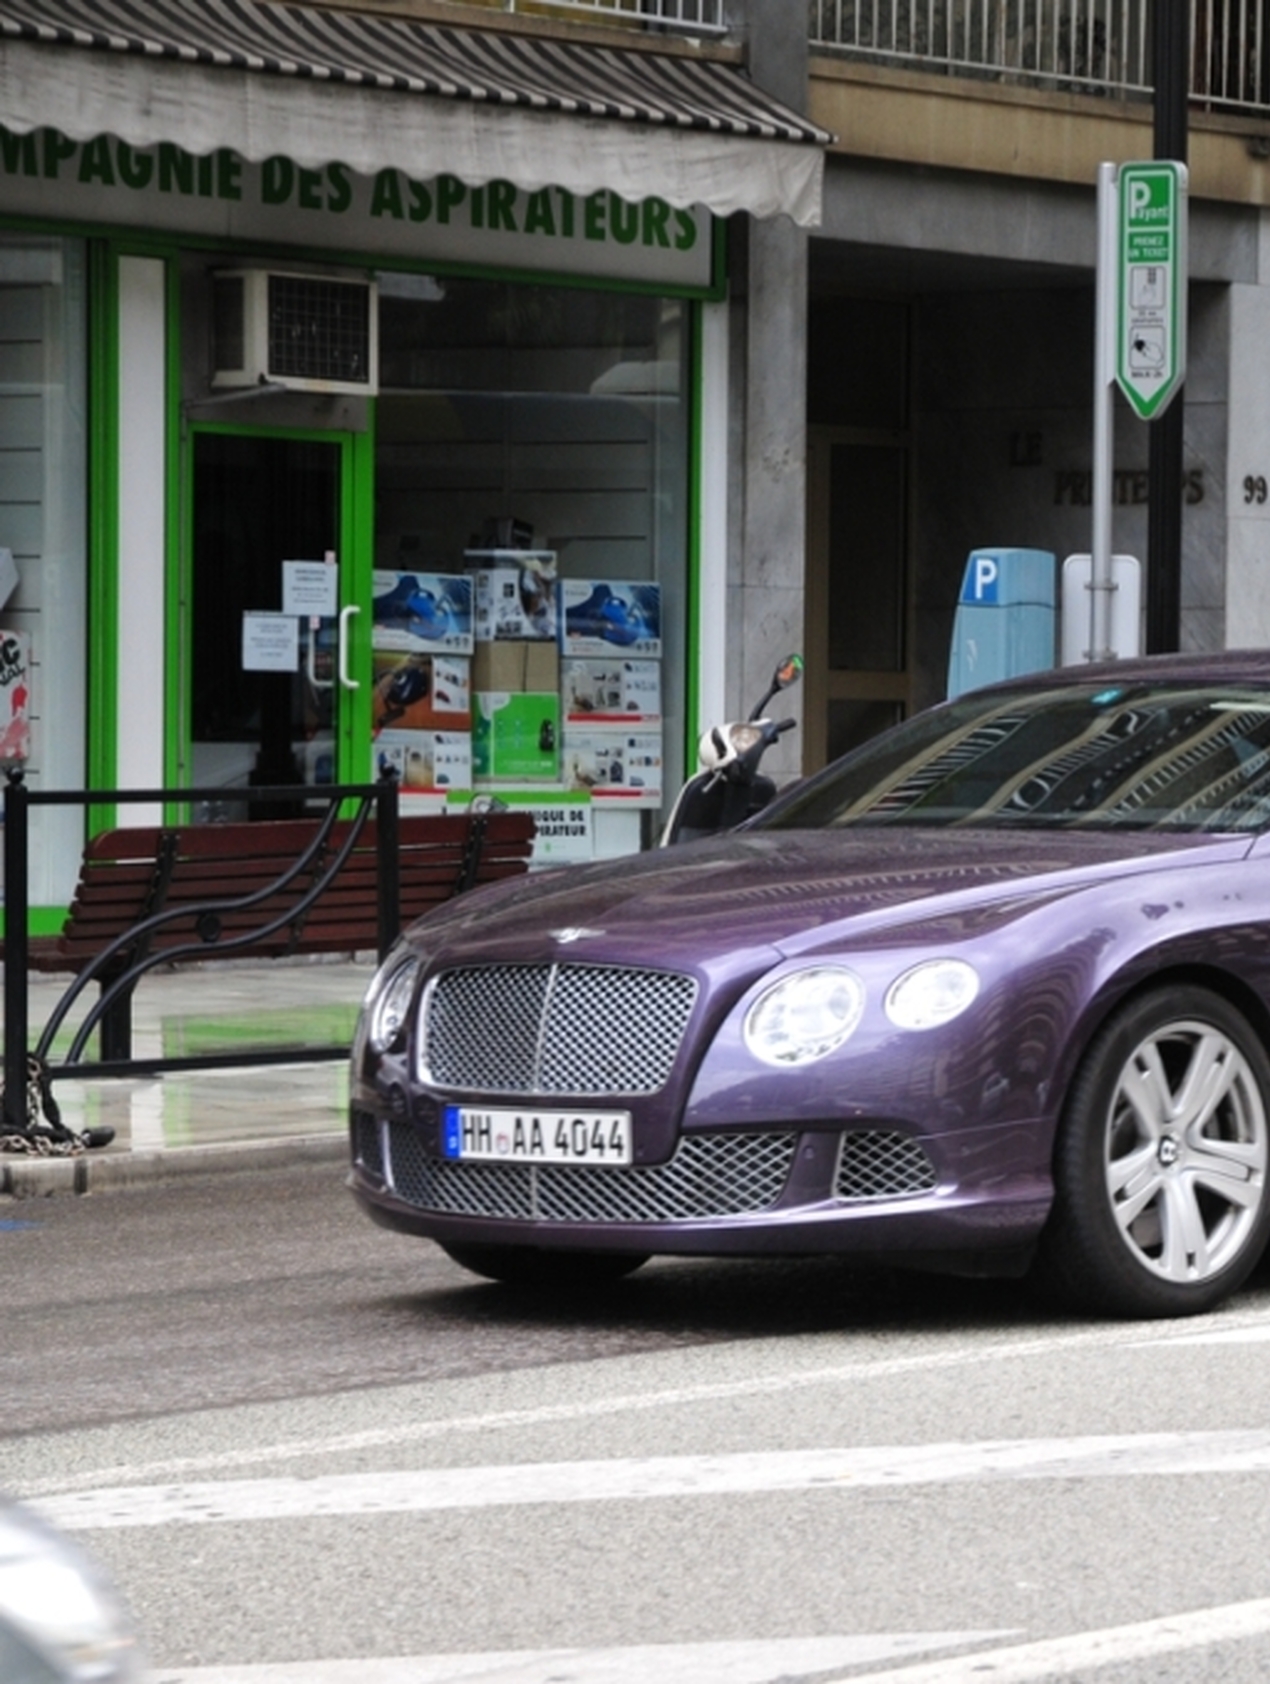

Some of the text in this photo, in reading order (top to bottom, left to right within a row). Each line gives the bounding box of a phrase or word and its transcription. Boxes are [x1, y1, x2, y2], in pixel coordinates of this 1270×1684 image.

[262, 155, 352, 213] DES
[370, 167, 697, 251] ASPIRATEURS
[1009, 431, 1043, 467] LE
[1243, 474, 1268, 505] 99
[975, 558, 997, 599] P
[570, 810, 584, 821] DE
[463, 1115, 624, 1157] HH AA 4044
